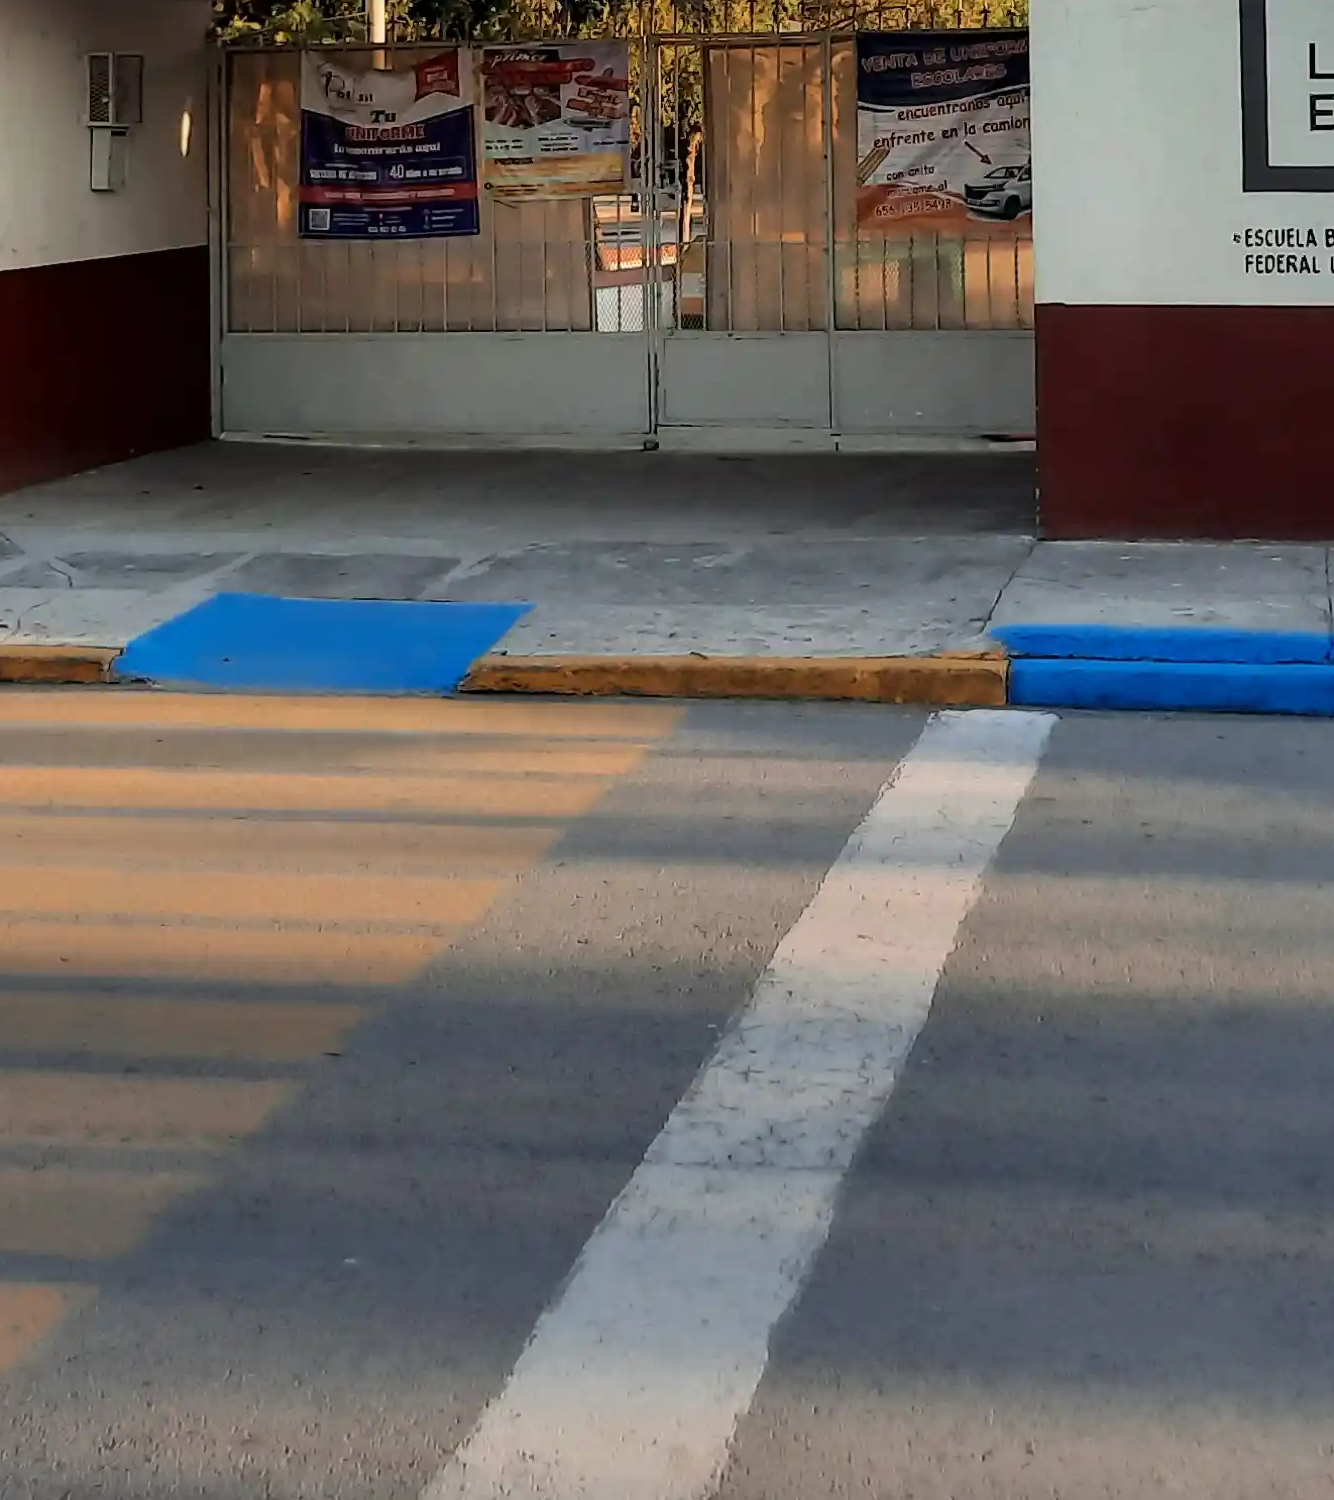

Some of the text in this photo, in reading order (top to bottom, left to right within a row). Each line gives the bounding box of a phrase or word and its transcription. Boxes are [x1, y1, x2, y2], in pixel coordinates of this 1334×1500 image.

[873, 133, 936, 150] enfrente
[942, 128, 959, 140] en
[963, 122, 977, 136] la
[1246, 255, 1320, 273] FEDERAL
